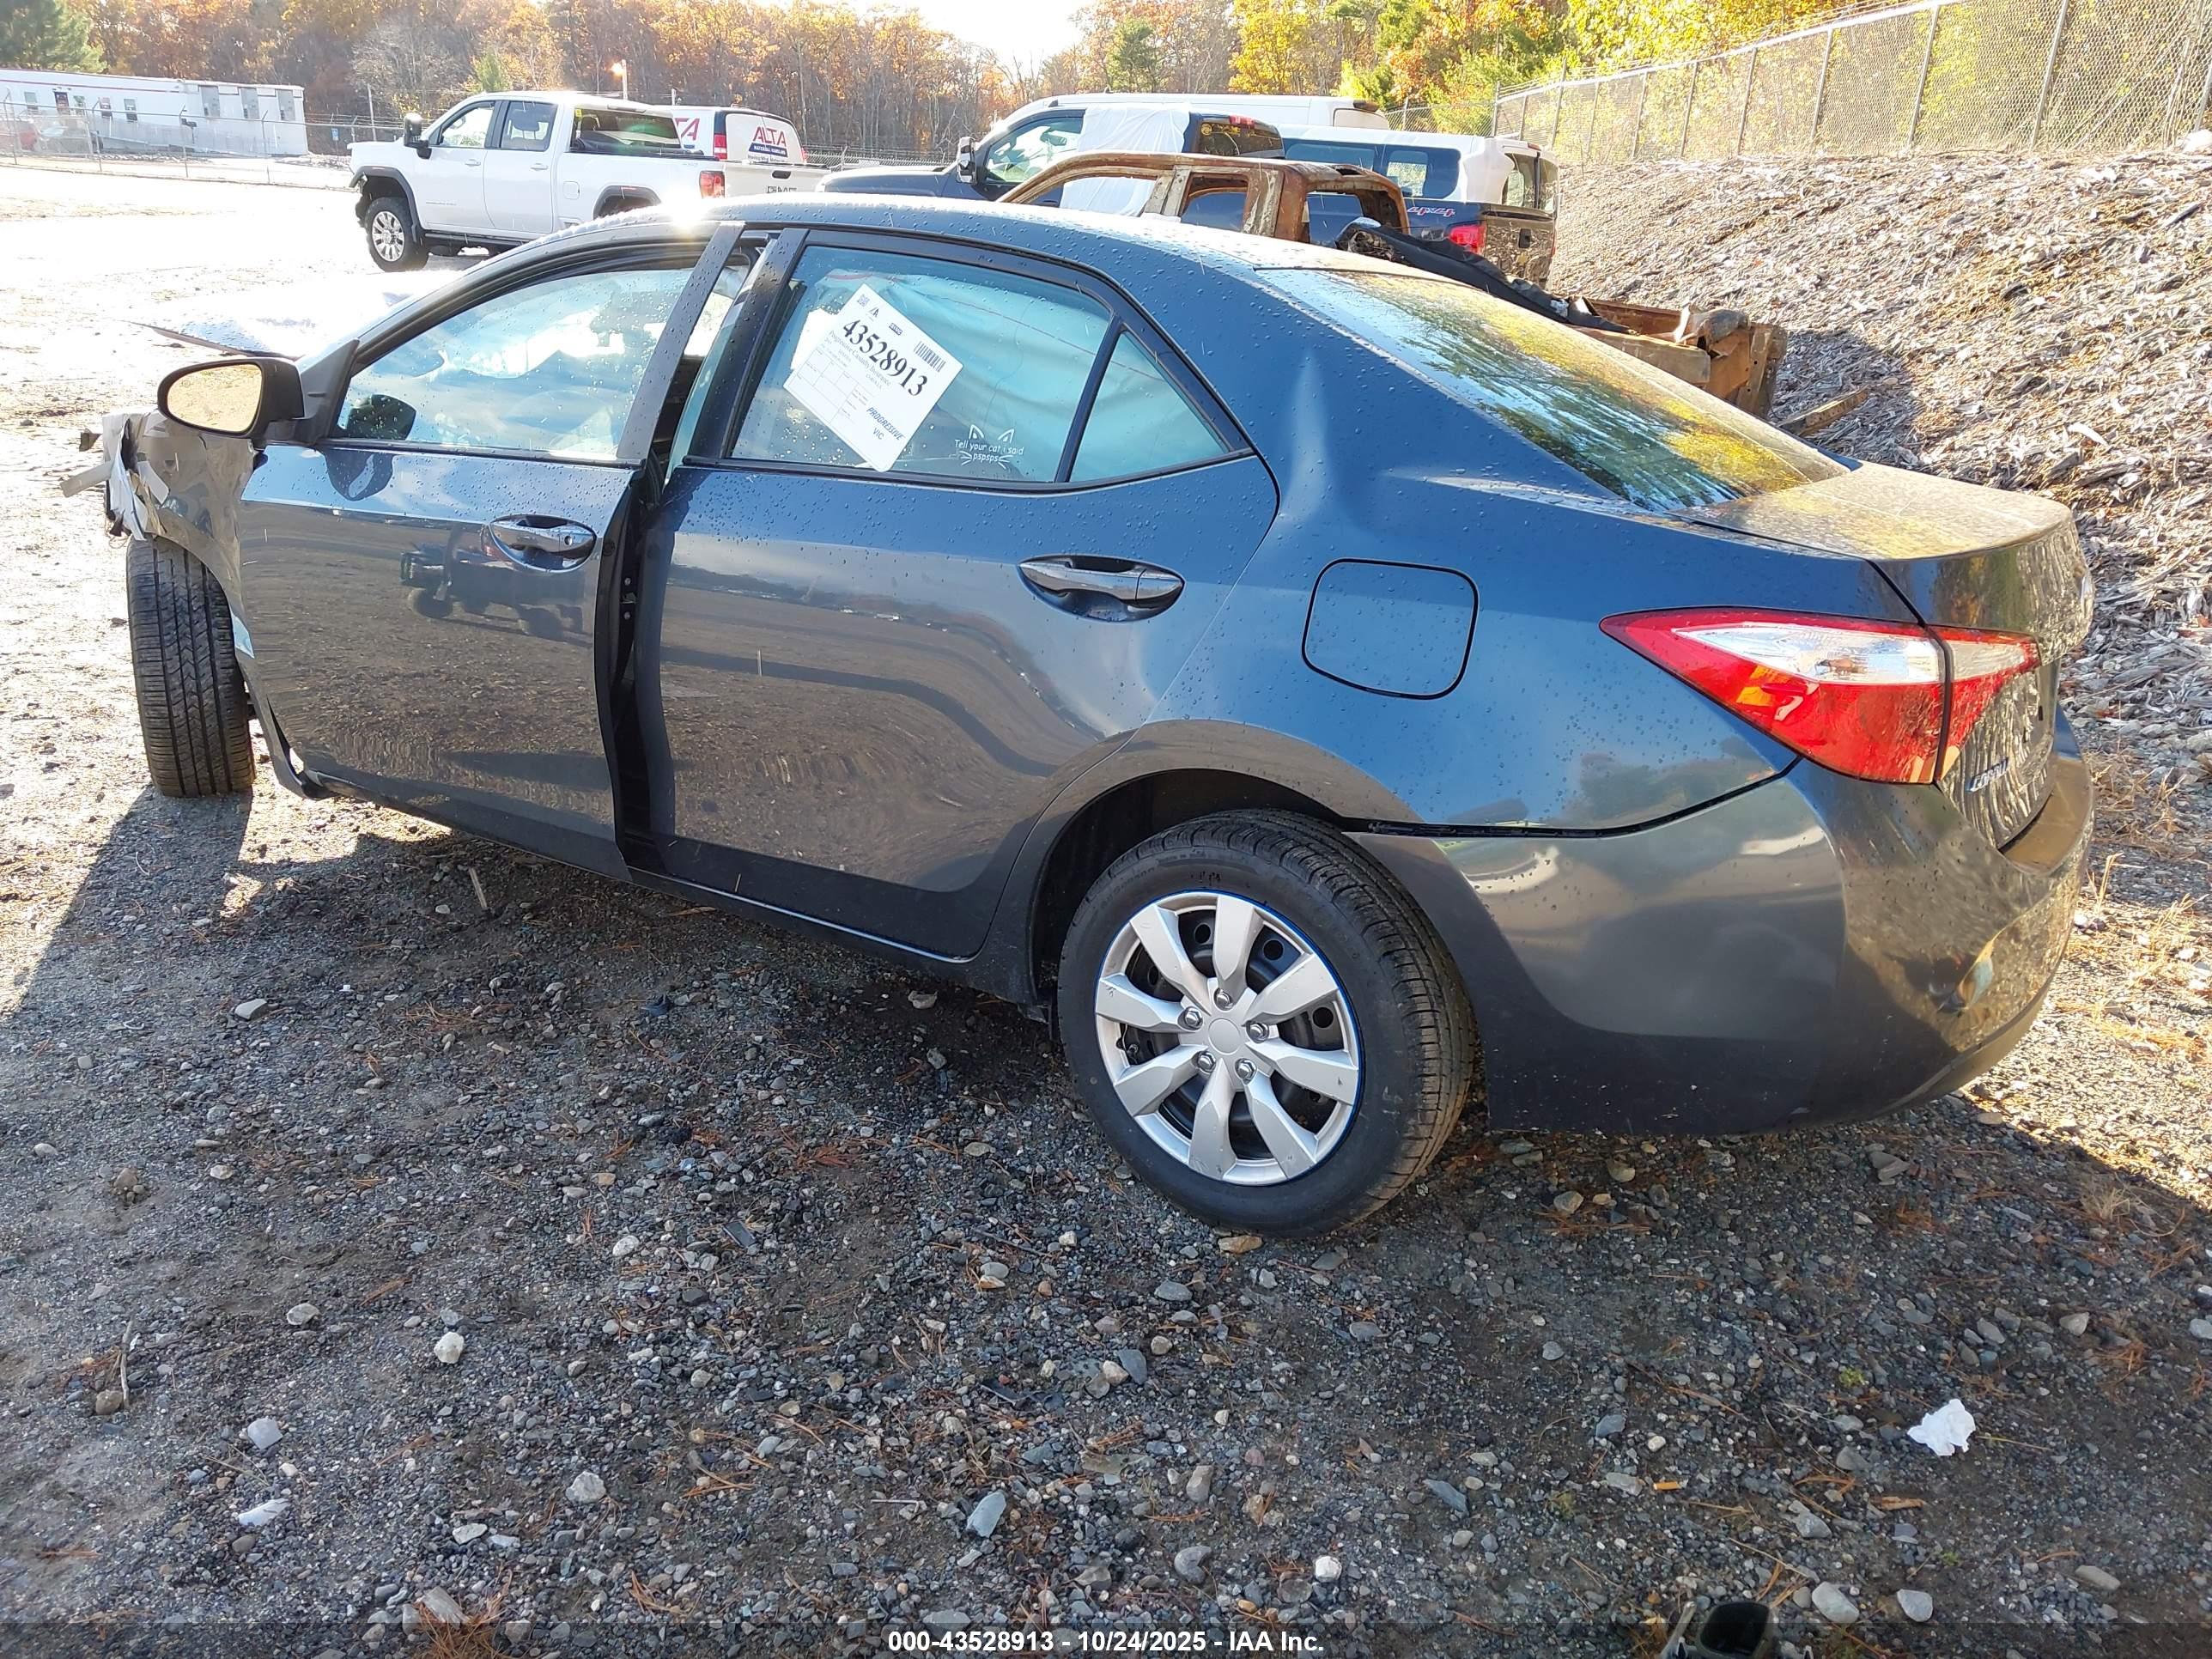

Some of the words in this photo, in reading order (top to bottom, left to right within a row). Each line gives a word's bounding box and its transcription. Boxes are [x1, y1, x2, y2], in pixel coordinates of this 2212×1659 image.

[752, 126, 787, 147] ALTA
[842, 319, 928, 396] 43528913
[866, 407, 906, 440] PROGRESSIVE
[873, 428, 884, 440] VIC
[955, 439, 969, 449] Tell
[969, 442, 988, 452] your
[988, 444, 1001, 453] cat
[1007, 447, 1024, 455] said
[972, 453, 1000, 464] pspsps
